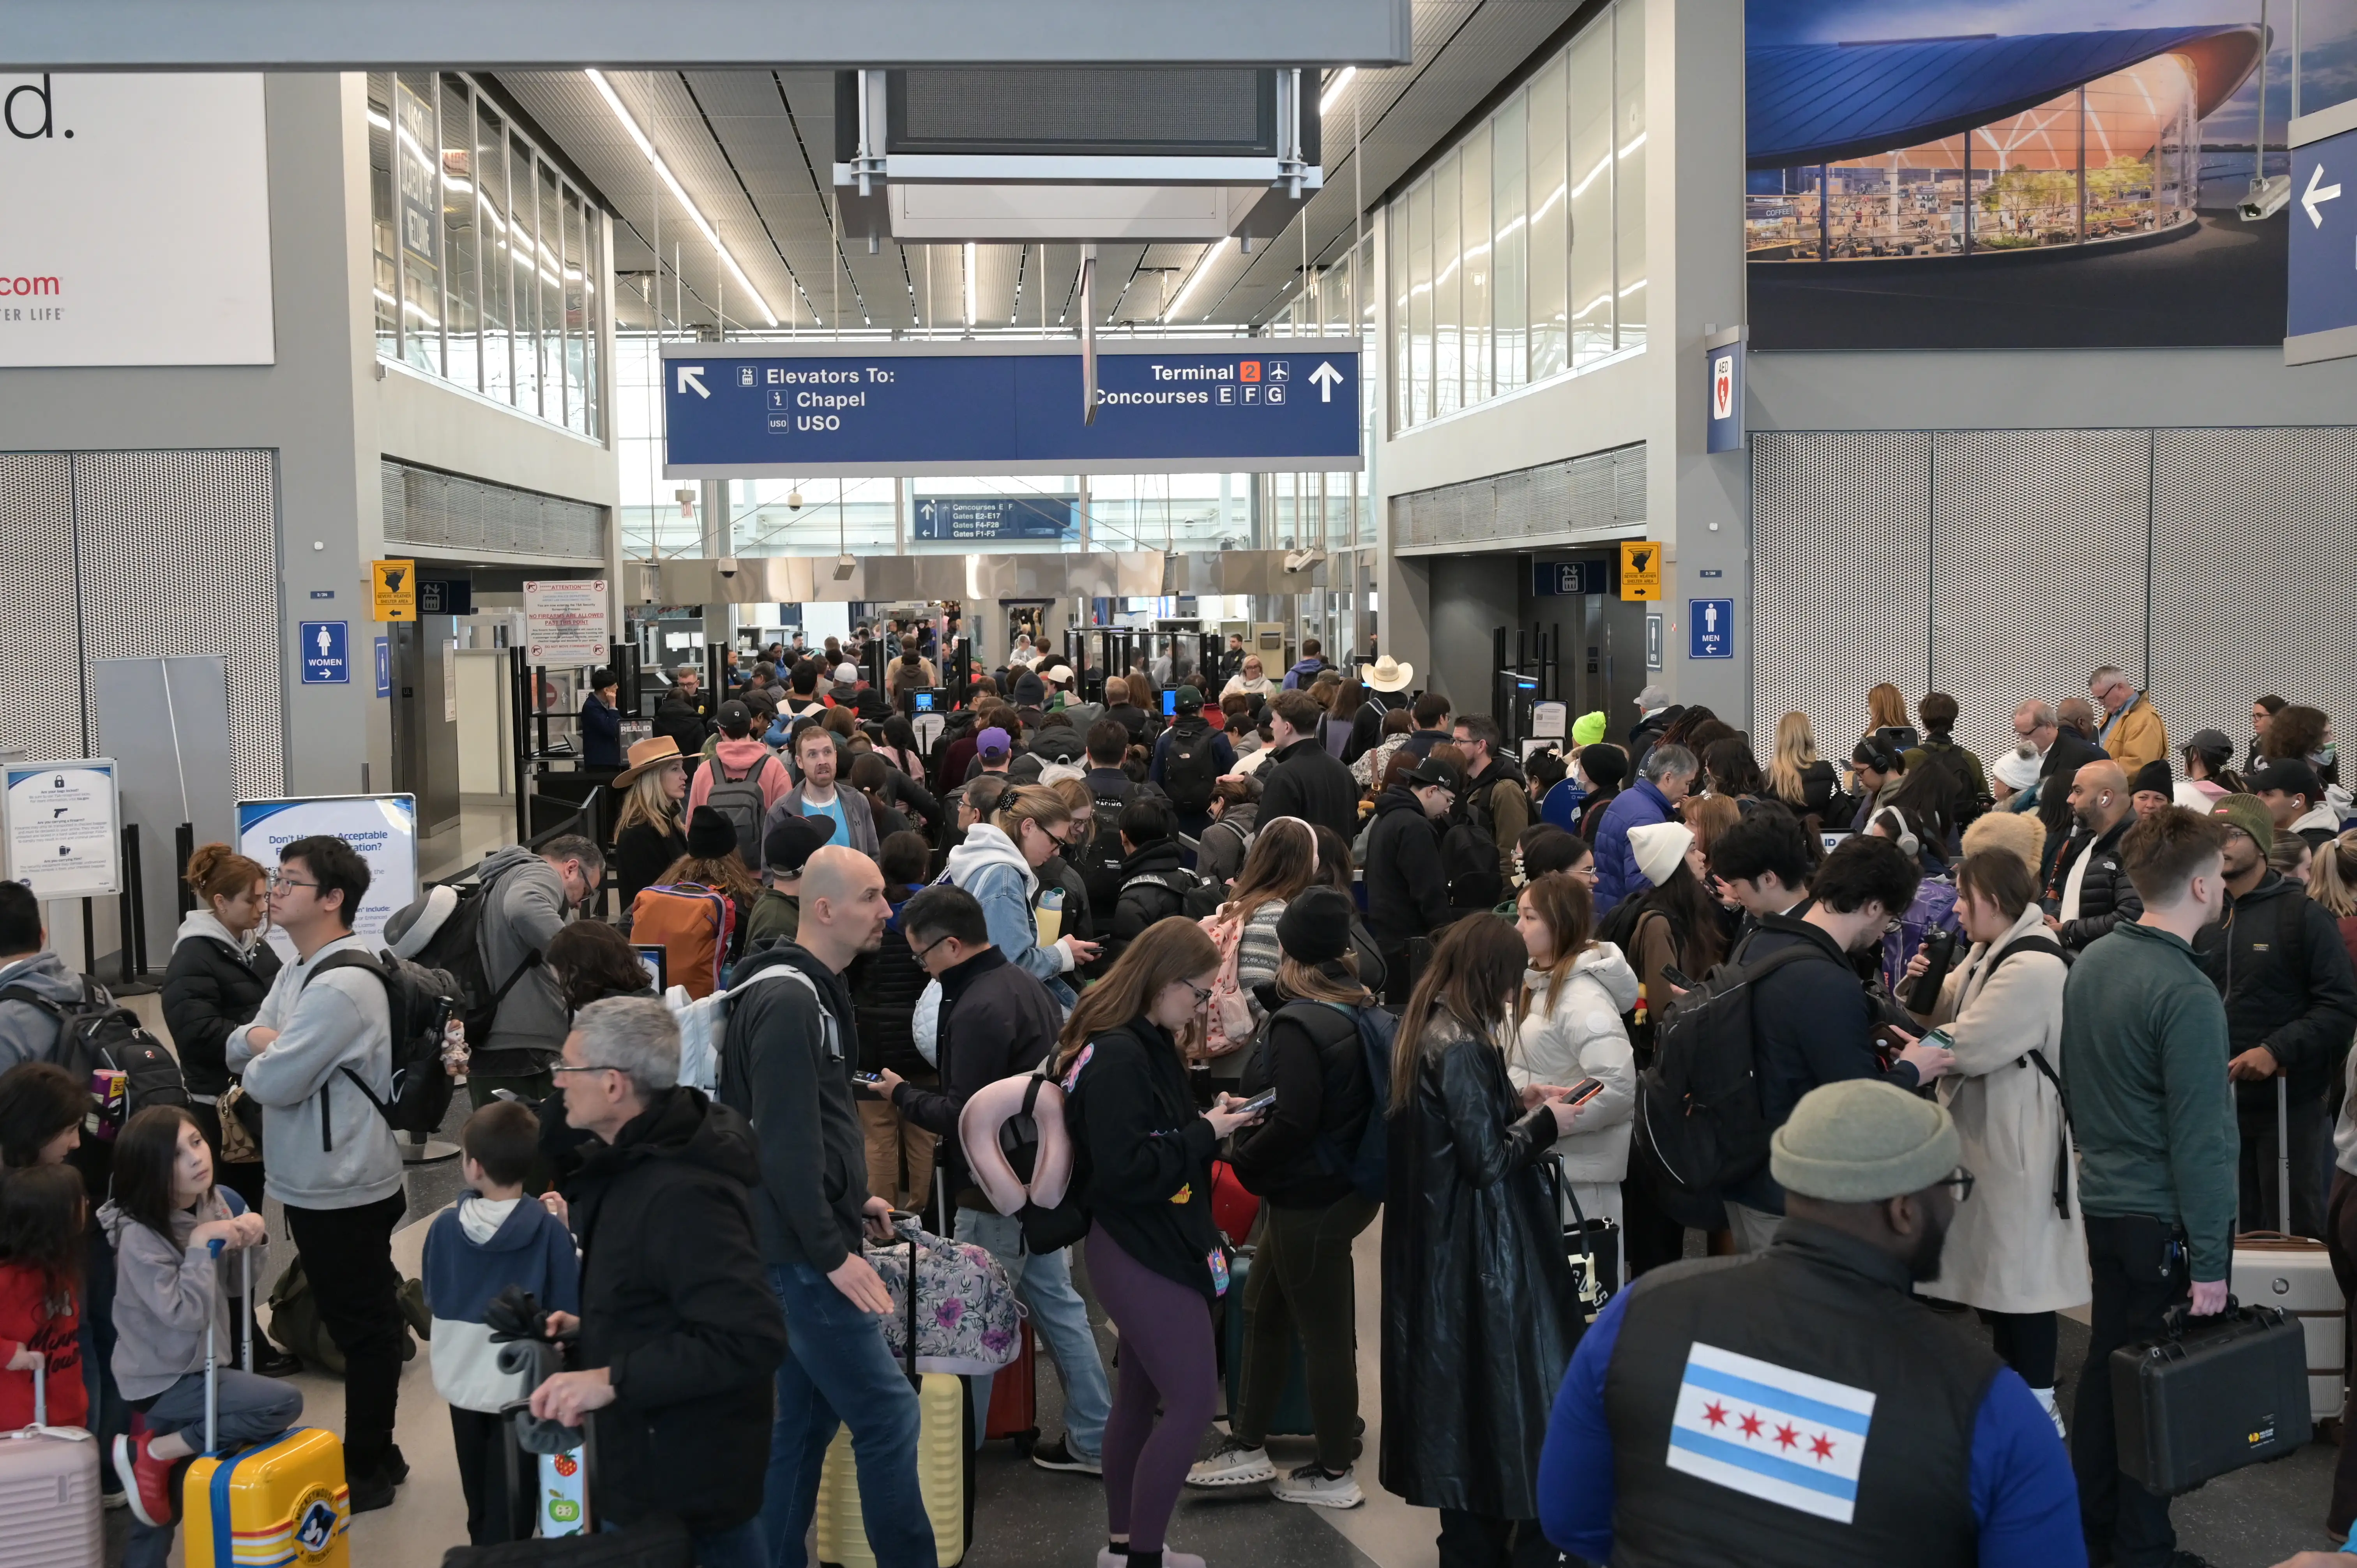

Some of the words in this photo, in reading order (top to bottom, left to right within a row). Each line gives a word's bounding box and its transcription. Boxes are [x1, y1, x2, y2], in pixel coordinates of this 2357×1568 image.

[1766, 208, 1790, 216] COFFEE
[0, 309, 21, 321] ER
[1152, 365, 1233, 380] Terminal
[1246, 366, 1255, 378] 2
[1718, 360, 1728, 374] AED
[767, 369, 859, 383] Elevators
[866, 369, 894, 383] To:
[797, 392, 865, 410] Chapel
[1097, 390, 1208, 404] Concourses
[1220, 390, 1231, 402] E
[1246, 390, 1255, 401] F
[1269, 389, 1281, 402] G
[797, 416, 840, 431] USO
[269, 835, 295, 844] Don't
[338, 831, 388, 841] Acceptable
[1825, 839, 1836, 847] ID
